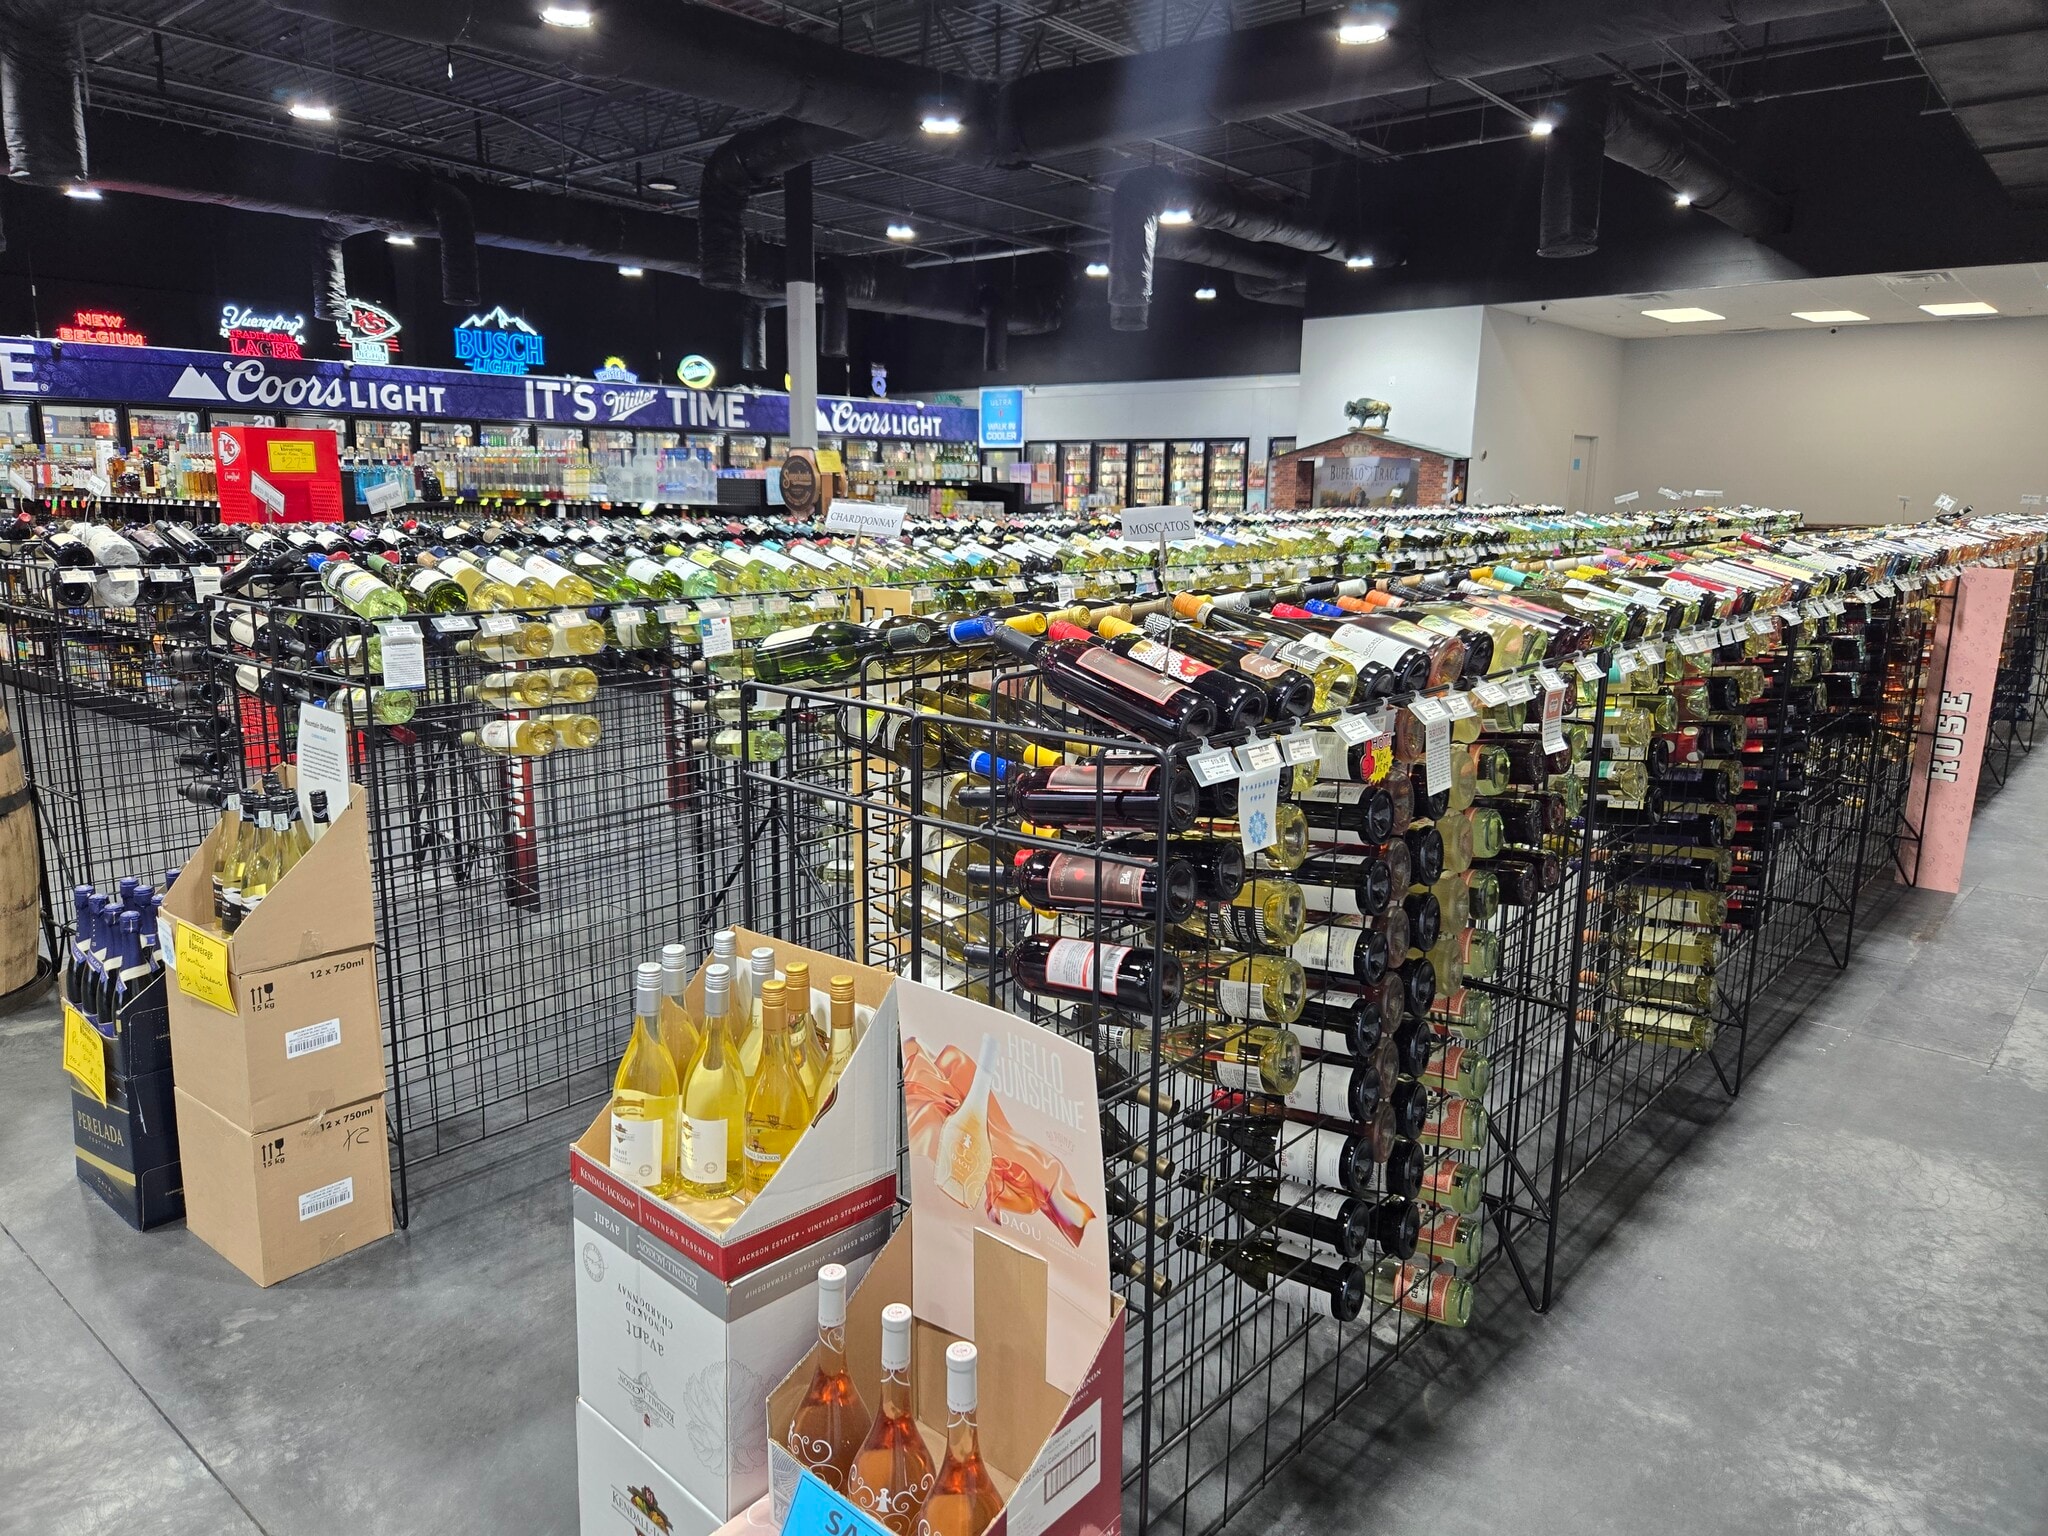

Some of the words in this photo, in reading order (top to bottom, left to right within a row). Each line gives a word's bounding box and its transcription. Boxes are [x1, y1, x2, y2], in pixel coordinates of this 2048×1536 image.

[77, 312, 122, 328] NEW
[221, 306, 304, 332] Yuengling
[60, 328, 144, 346] BELGIUM
[229, 329, 295, 342] TRADITIONAL
[229, 338, 303, 359] LAGER
[454, 328, 545, 366] BUSCH
[472, 358, 526, 375] LIGHT
[223, 359, 347, 408] Coors
[351, 381, 446, 413] LIGHT
[525, 380, 597, 422] IT'S
[603, 389, 660, 421] Miller
[665, 389, 746, 428] TIME
[95, 409, 117, 423] 18
[177, 412, 199, 426] 19
[253, 415, 276, 427] 20
[831, 401, 892, 435] Coors
[892, 417, 942, 437] LIGHT
[392, 421, 412, 435] 22
[454, 424, 473, 437] 23
[513, 427, 530, 439] 24
[568, 429, 584, 441] 25
[987, 423, 1007, 431] WALK
[1008, 423, 1016, 431] IN
[619, 431, 634, 444] 26
[711, 434, 725, 447] 28
[753, 435, 767, 448] 29
[986, 431, 1017, 441] COOLER
[867, 440, 879, 452] 32
[900, 441, 912, 453] 33
[1044, 444, 1057, 455] 36
[1189, 441, 1204, 454] 40
[1231, 441, 1245, 454] 41
[1330, 464, 1365, 481] BUFFALO
[1374, 464, 1400, 481] TRACE
[1128, 519, 1191, 536] MOSCATOS
[1926, 691, 1972, 783] ROSE
[191, 943, 214, 960] beverage
[310, 969, 322, 980] 12
[325, 968, 332, 976] x
[334, 957, 365, 973] 750ml
[252, 1004, 263, 1013] 15
[264, 1002, 275, 1010] kg
[1007, 1031, 1064, 1094] HELLO
[992, 1055, 1087, 1133] SUNSHINE
[320, 1120, 333, 1131] 12
[343, 1105, 374, 1123] 750ml
[77, 1110, 125, 1147] PERELADA
[262, 1161, 273, 1169] 15
[274, 1157, 285, 1165] kg
[594, 1211, 620, 1236] avant
[646, 1213, 679, 1240] VINTNER'S
[738, 1245, 769, 1265] JACKSON
[807, 1214, 839, 1233] VINEYARD
[840, 1194, 883, 1218] STEWARDSHIP
[1000, 1210, 1041, 1242] DAOU
[795, 1255, 826, 1275] VINEYARD
[745, 1271, 793, 1299] STEWARDSHIP
[617, 1283, 674, 1330] CHARDONNAY
[625, 1301, 665, 1336] UNOAKED
[626, 1320, 664, 1357] avant
[618, 1373, 675, 1424] KENDALL-JACKSON
[1031, 1462, 1047, 1479] DAOU
[1047, 1446, 1070, 1465] Cabernet
[1069, 1424, 1094, 1447] Sauvignon
